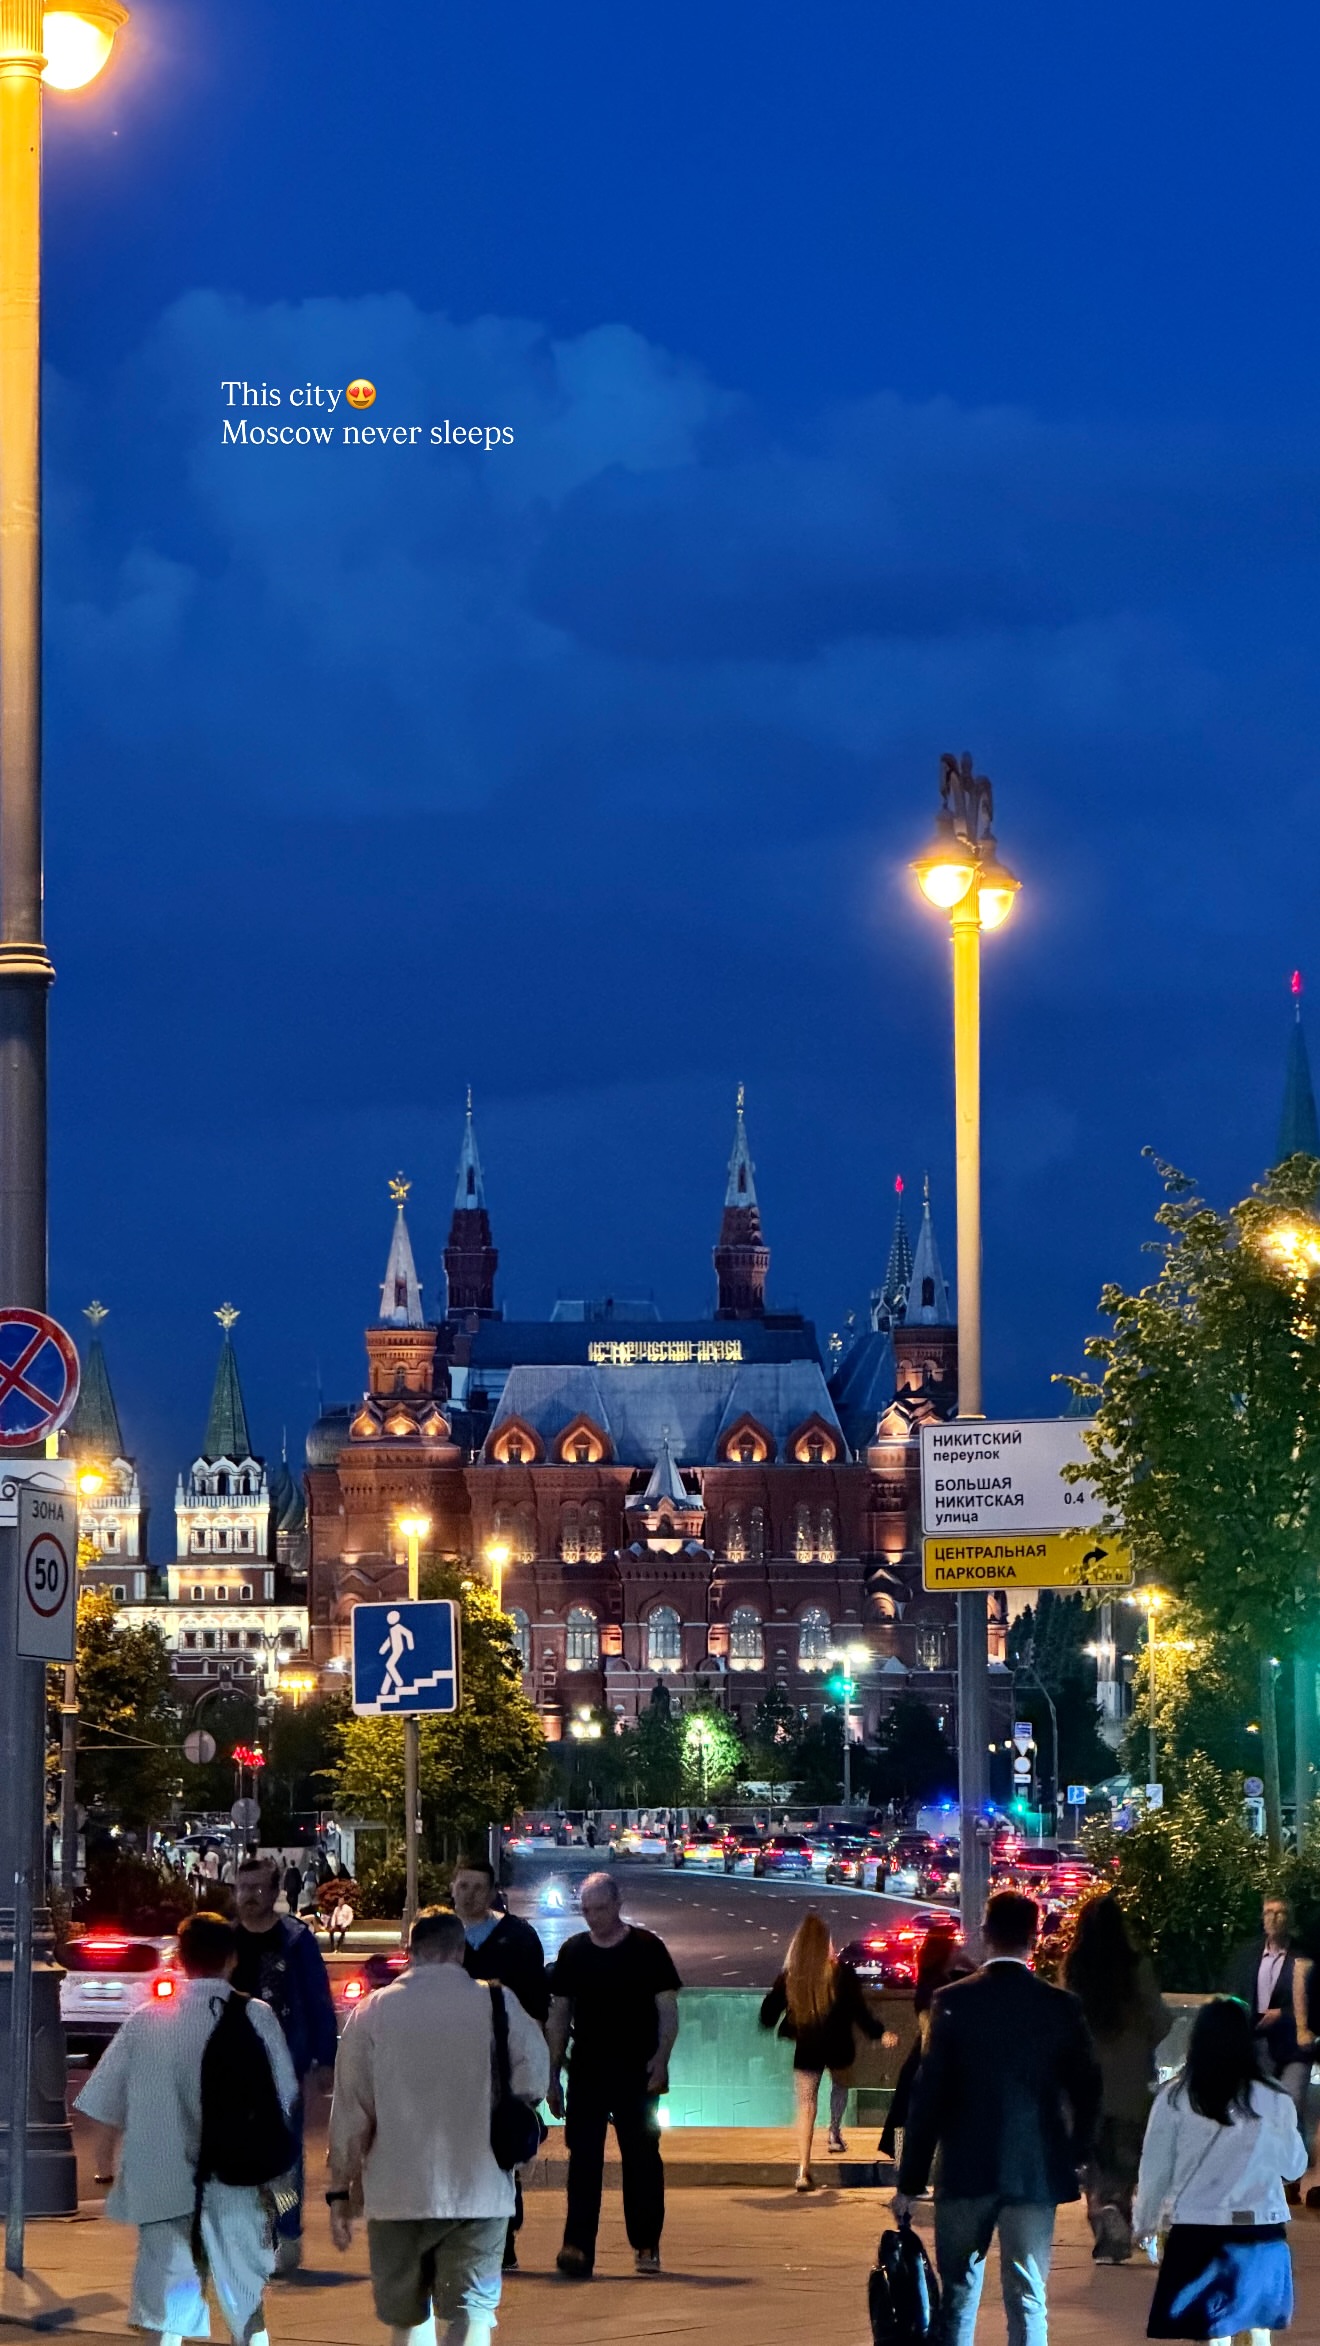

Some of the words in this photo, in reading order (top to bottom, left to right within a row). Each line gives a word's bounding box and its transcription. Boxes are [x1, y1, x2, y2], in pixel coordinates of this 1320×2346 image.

[933, 1430, 1022, 1447] НИКИТСКИЙ
[933, 1450, 1000, 1463] переулок
[935, 1477, 1012, 1492] БОЛЬШАЯ
[935, 1493, 1024, 1509] НИКИТСКАЯ
[1064, 1492, 1085, 1505] 0.4
[32, 1500, 65, 1523] ЗОНА
[935, 1512, 979, 1526] улица
[935, 1544, 1047, 1562] ЦЕНТРАЛЬНАЯ
[34, 1557, 59, 1592] 50
[935, 1565, 1017, 1580] ПАРКОВКА
